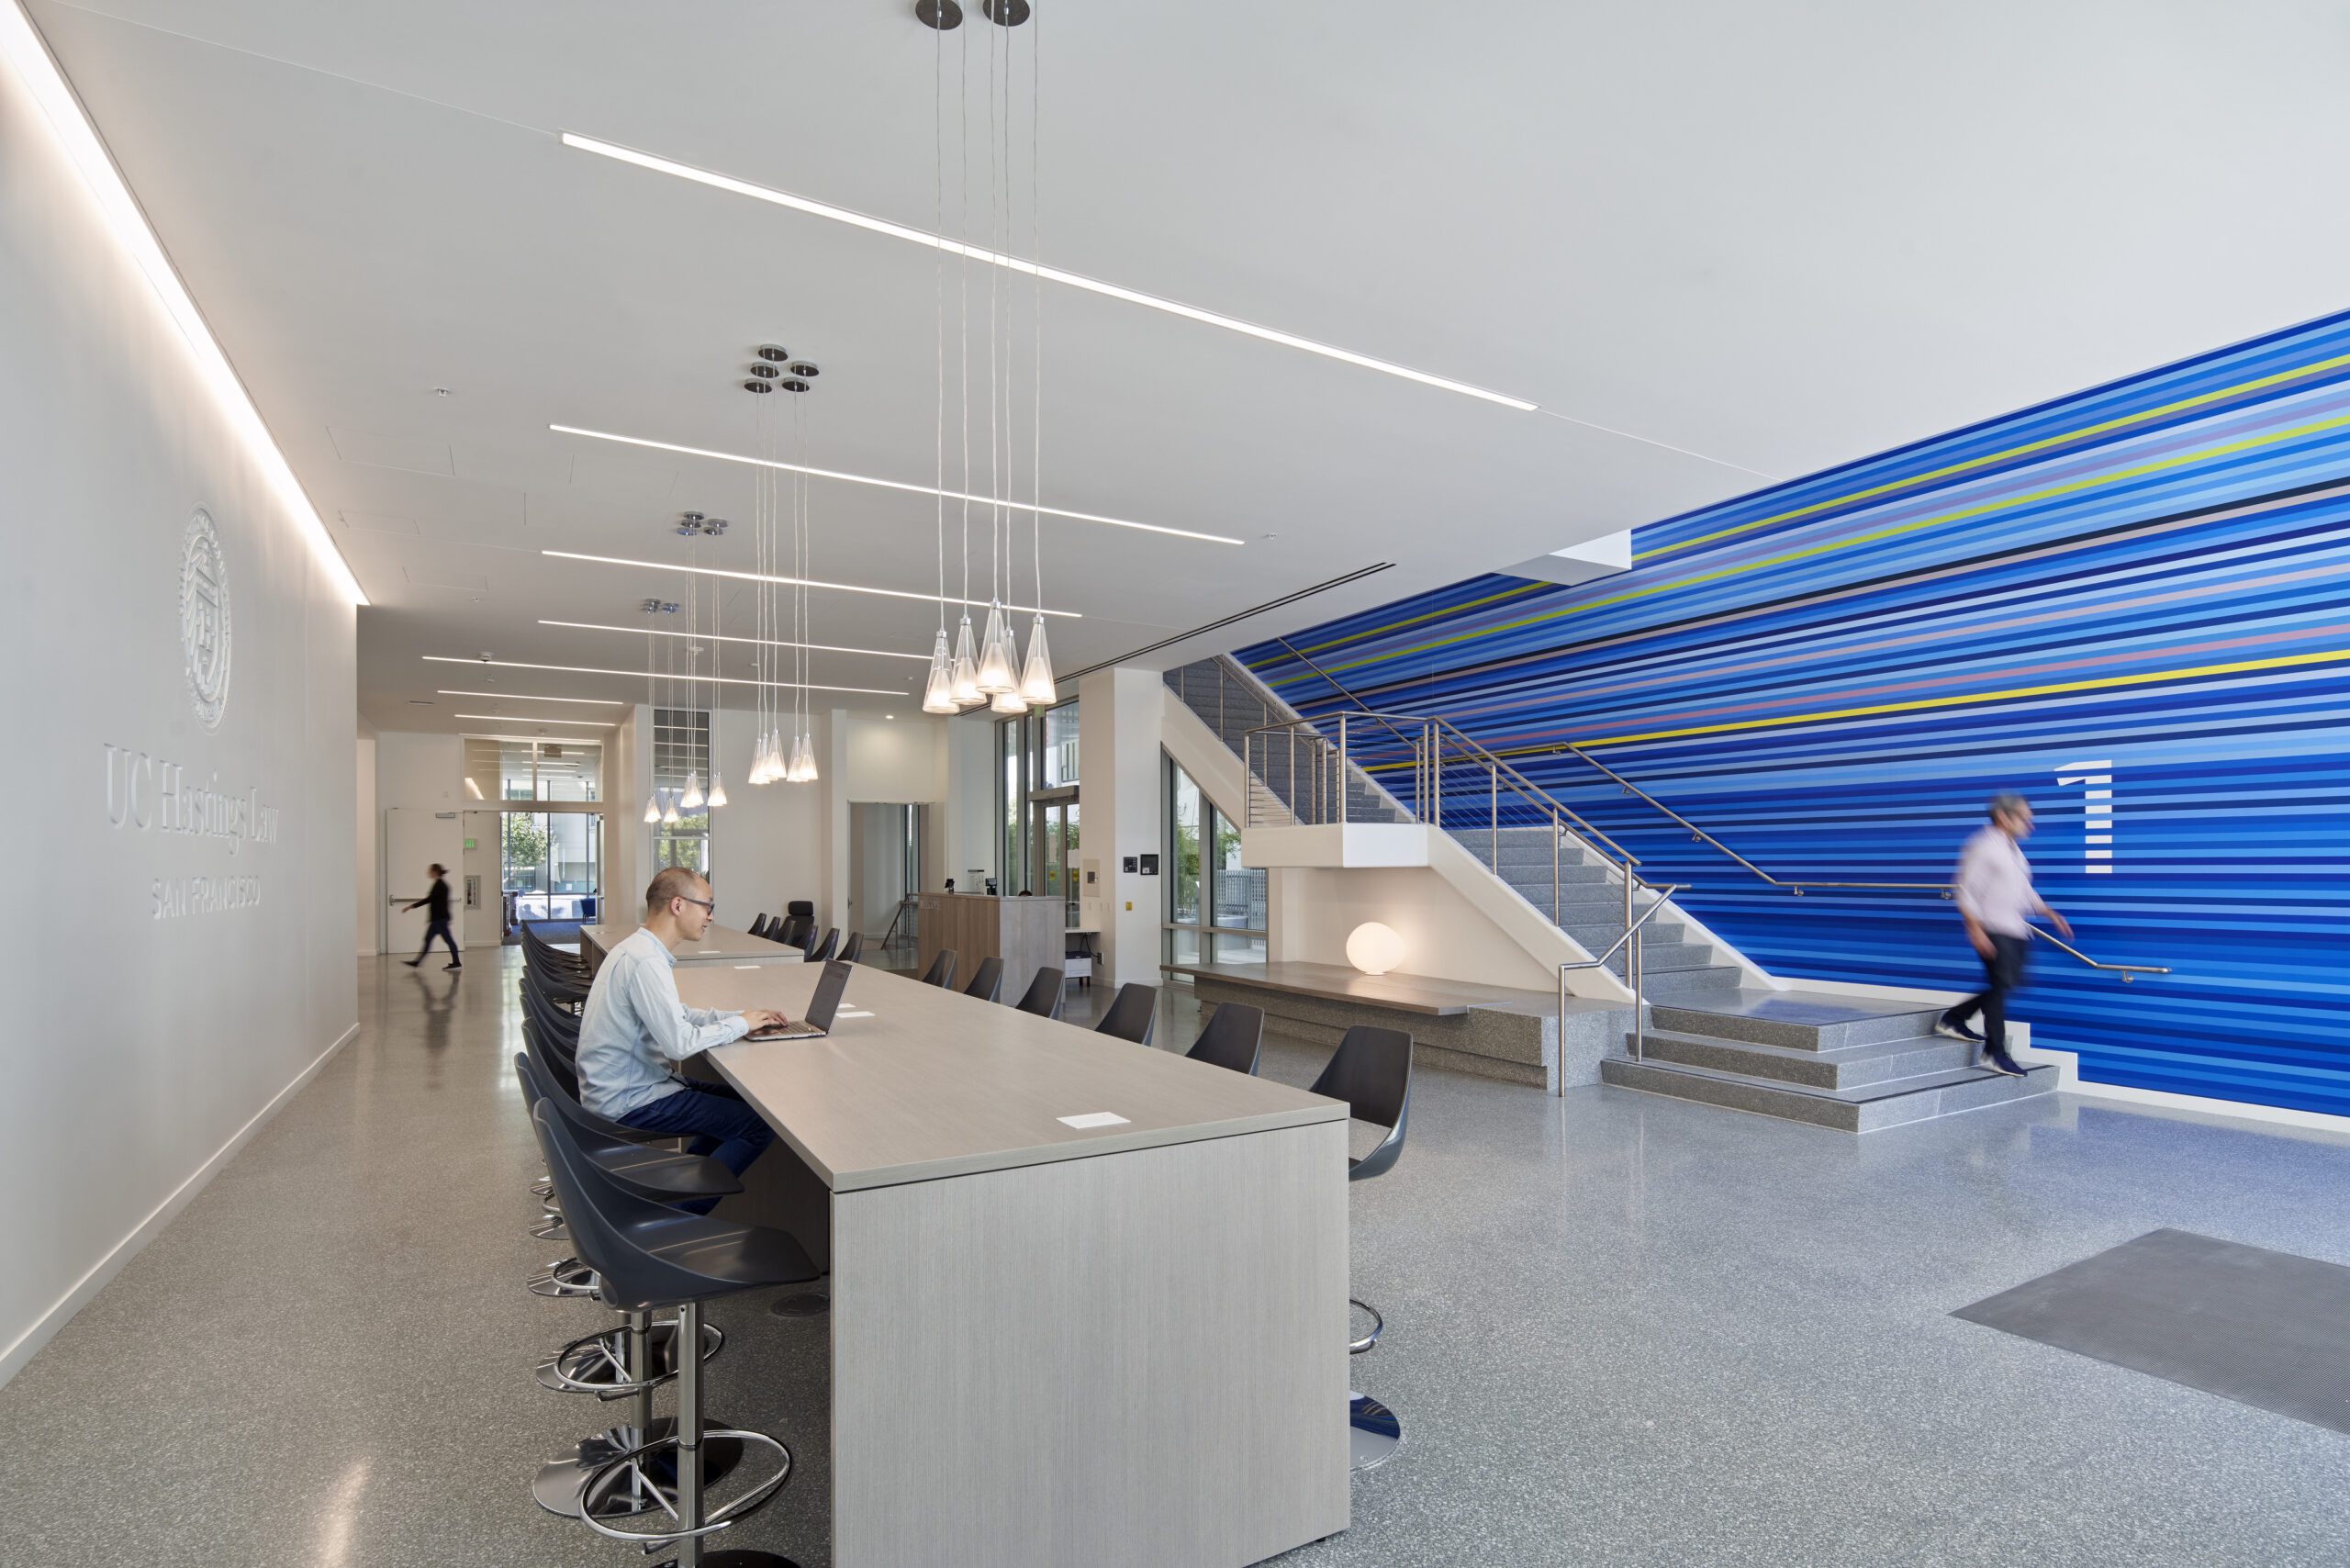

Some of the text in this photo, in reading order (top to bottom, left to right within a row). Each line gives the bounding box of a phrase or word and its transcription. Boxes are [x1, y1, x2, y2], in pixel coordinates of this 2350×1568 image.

[104, 743, 280, 857] UC Hastings Law
[2054, 759, 2112, 873] 1
[152, 876, 261, 919] SAN FRANCISCO
